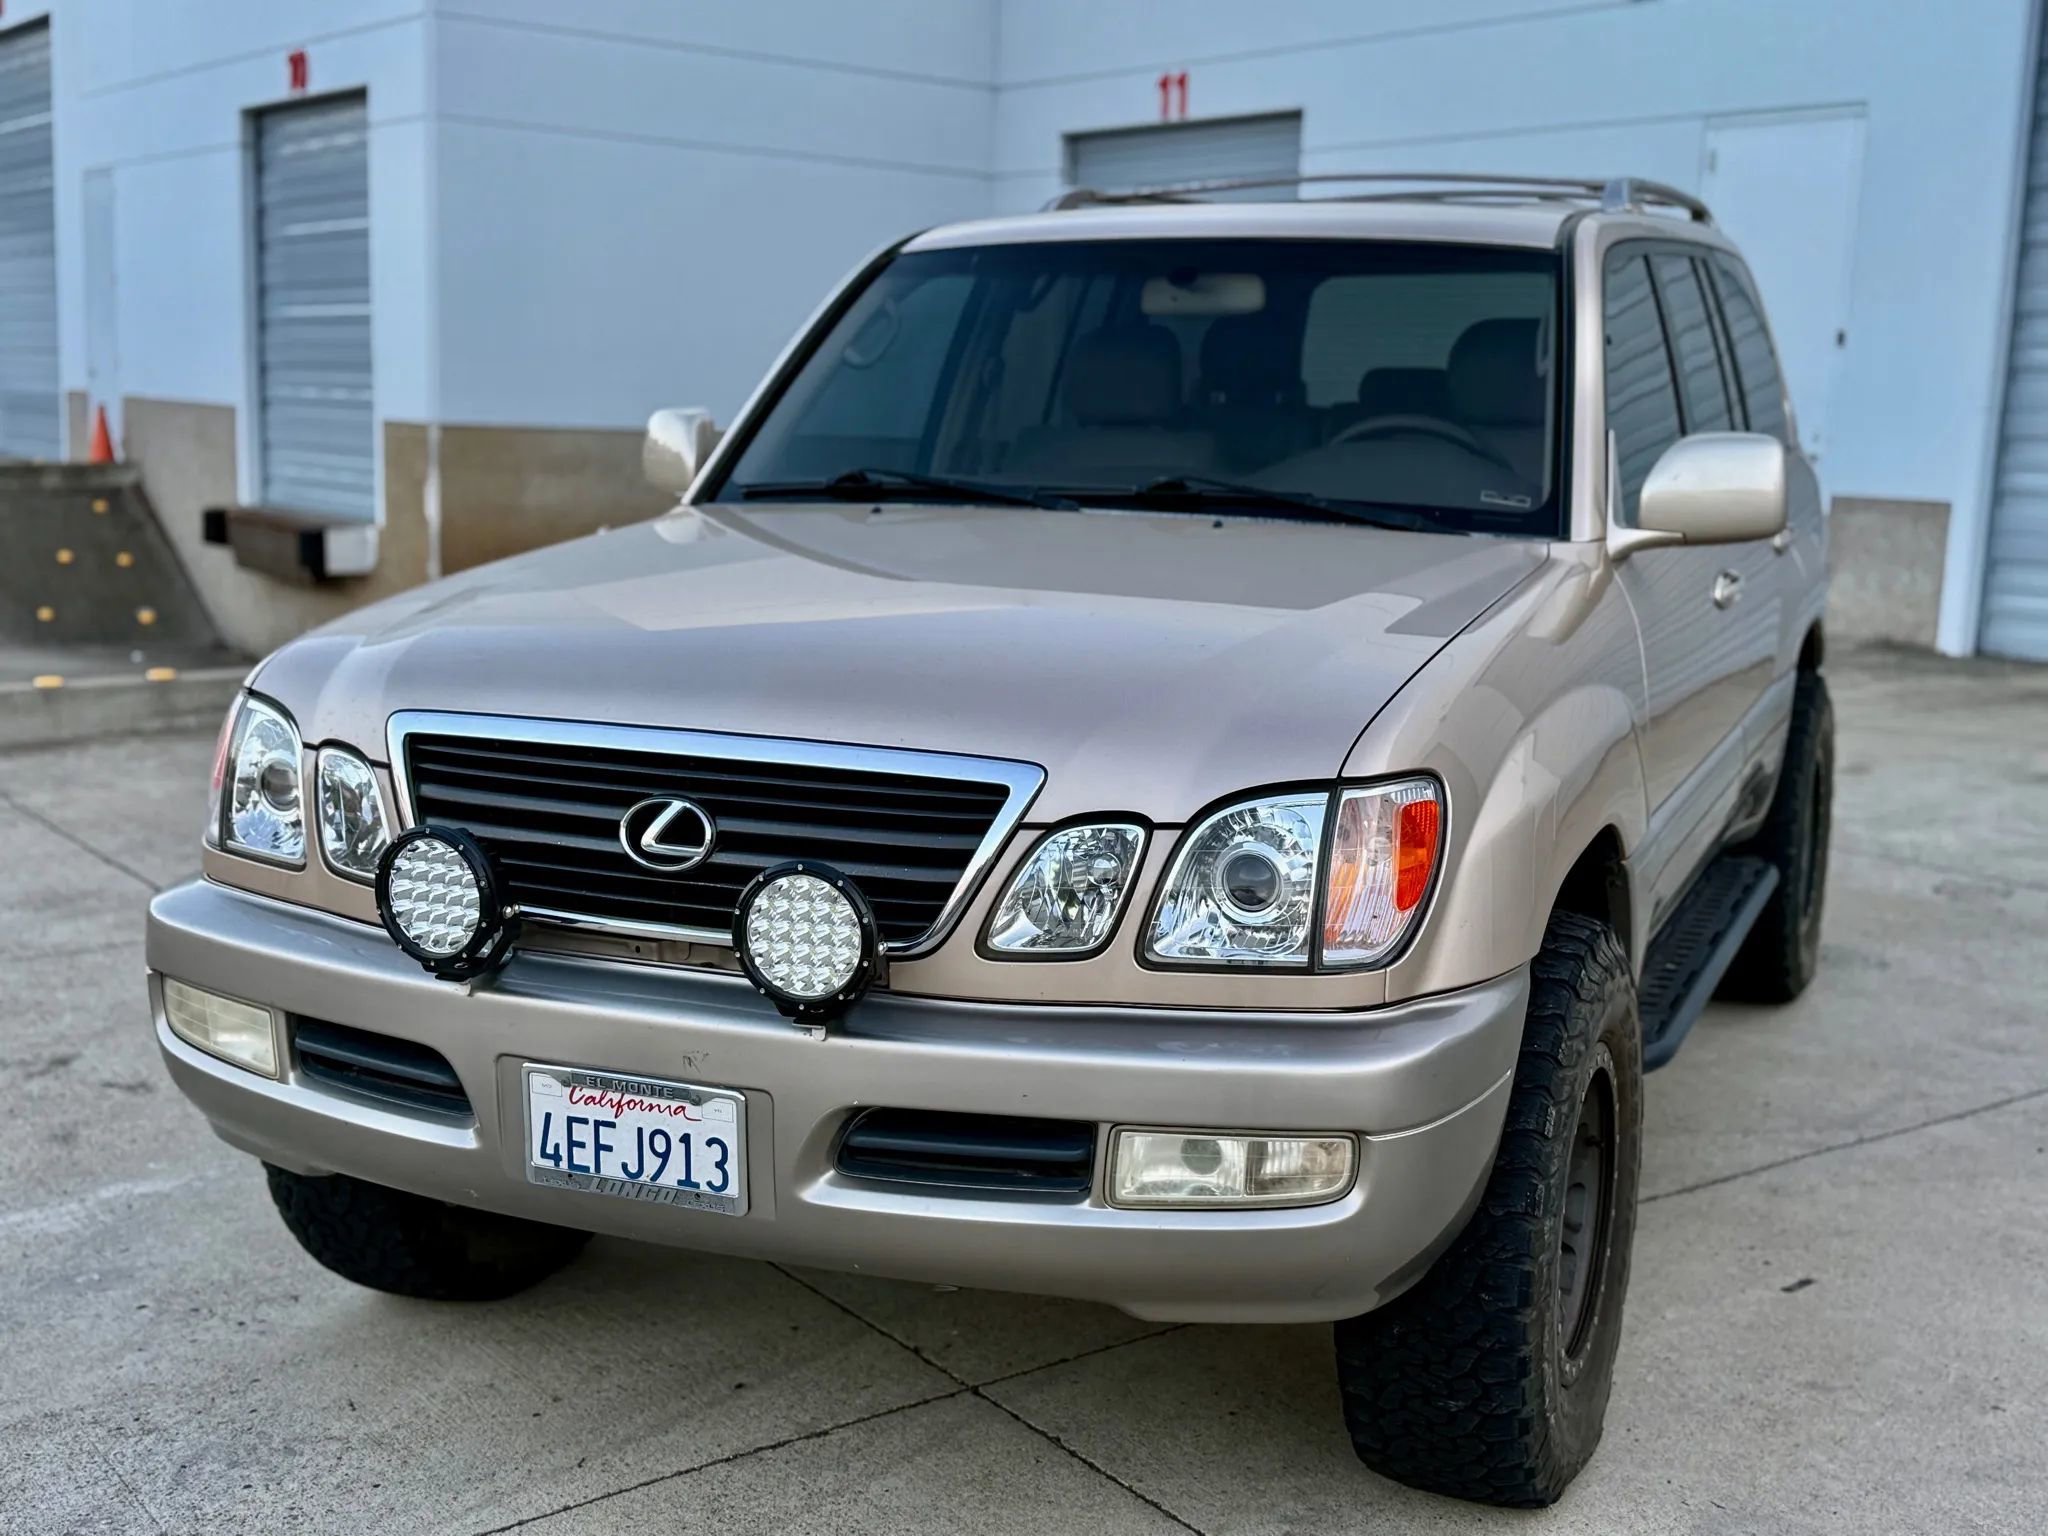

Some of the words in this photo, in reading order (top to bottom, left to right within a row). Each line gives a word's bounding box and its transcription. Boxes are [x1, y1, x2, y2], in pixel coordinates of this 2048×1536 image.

[1158, 71, 1189, 121] 11
[569, 1085, 702, 1121] California
[586, 1076, 606, 1089] EL
[612, 1080, 674, 1098] MONTE
[540, 1112, 729, 1192] 4EFJ913
[589, 1176, 676, 1204] LONGO
